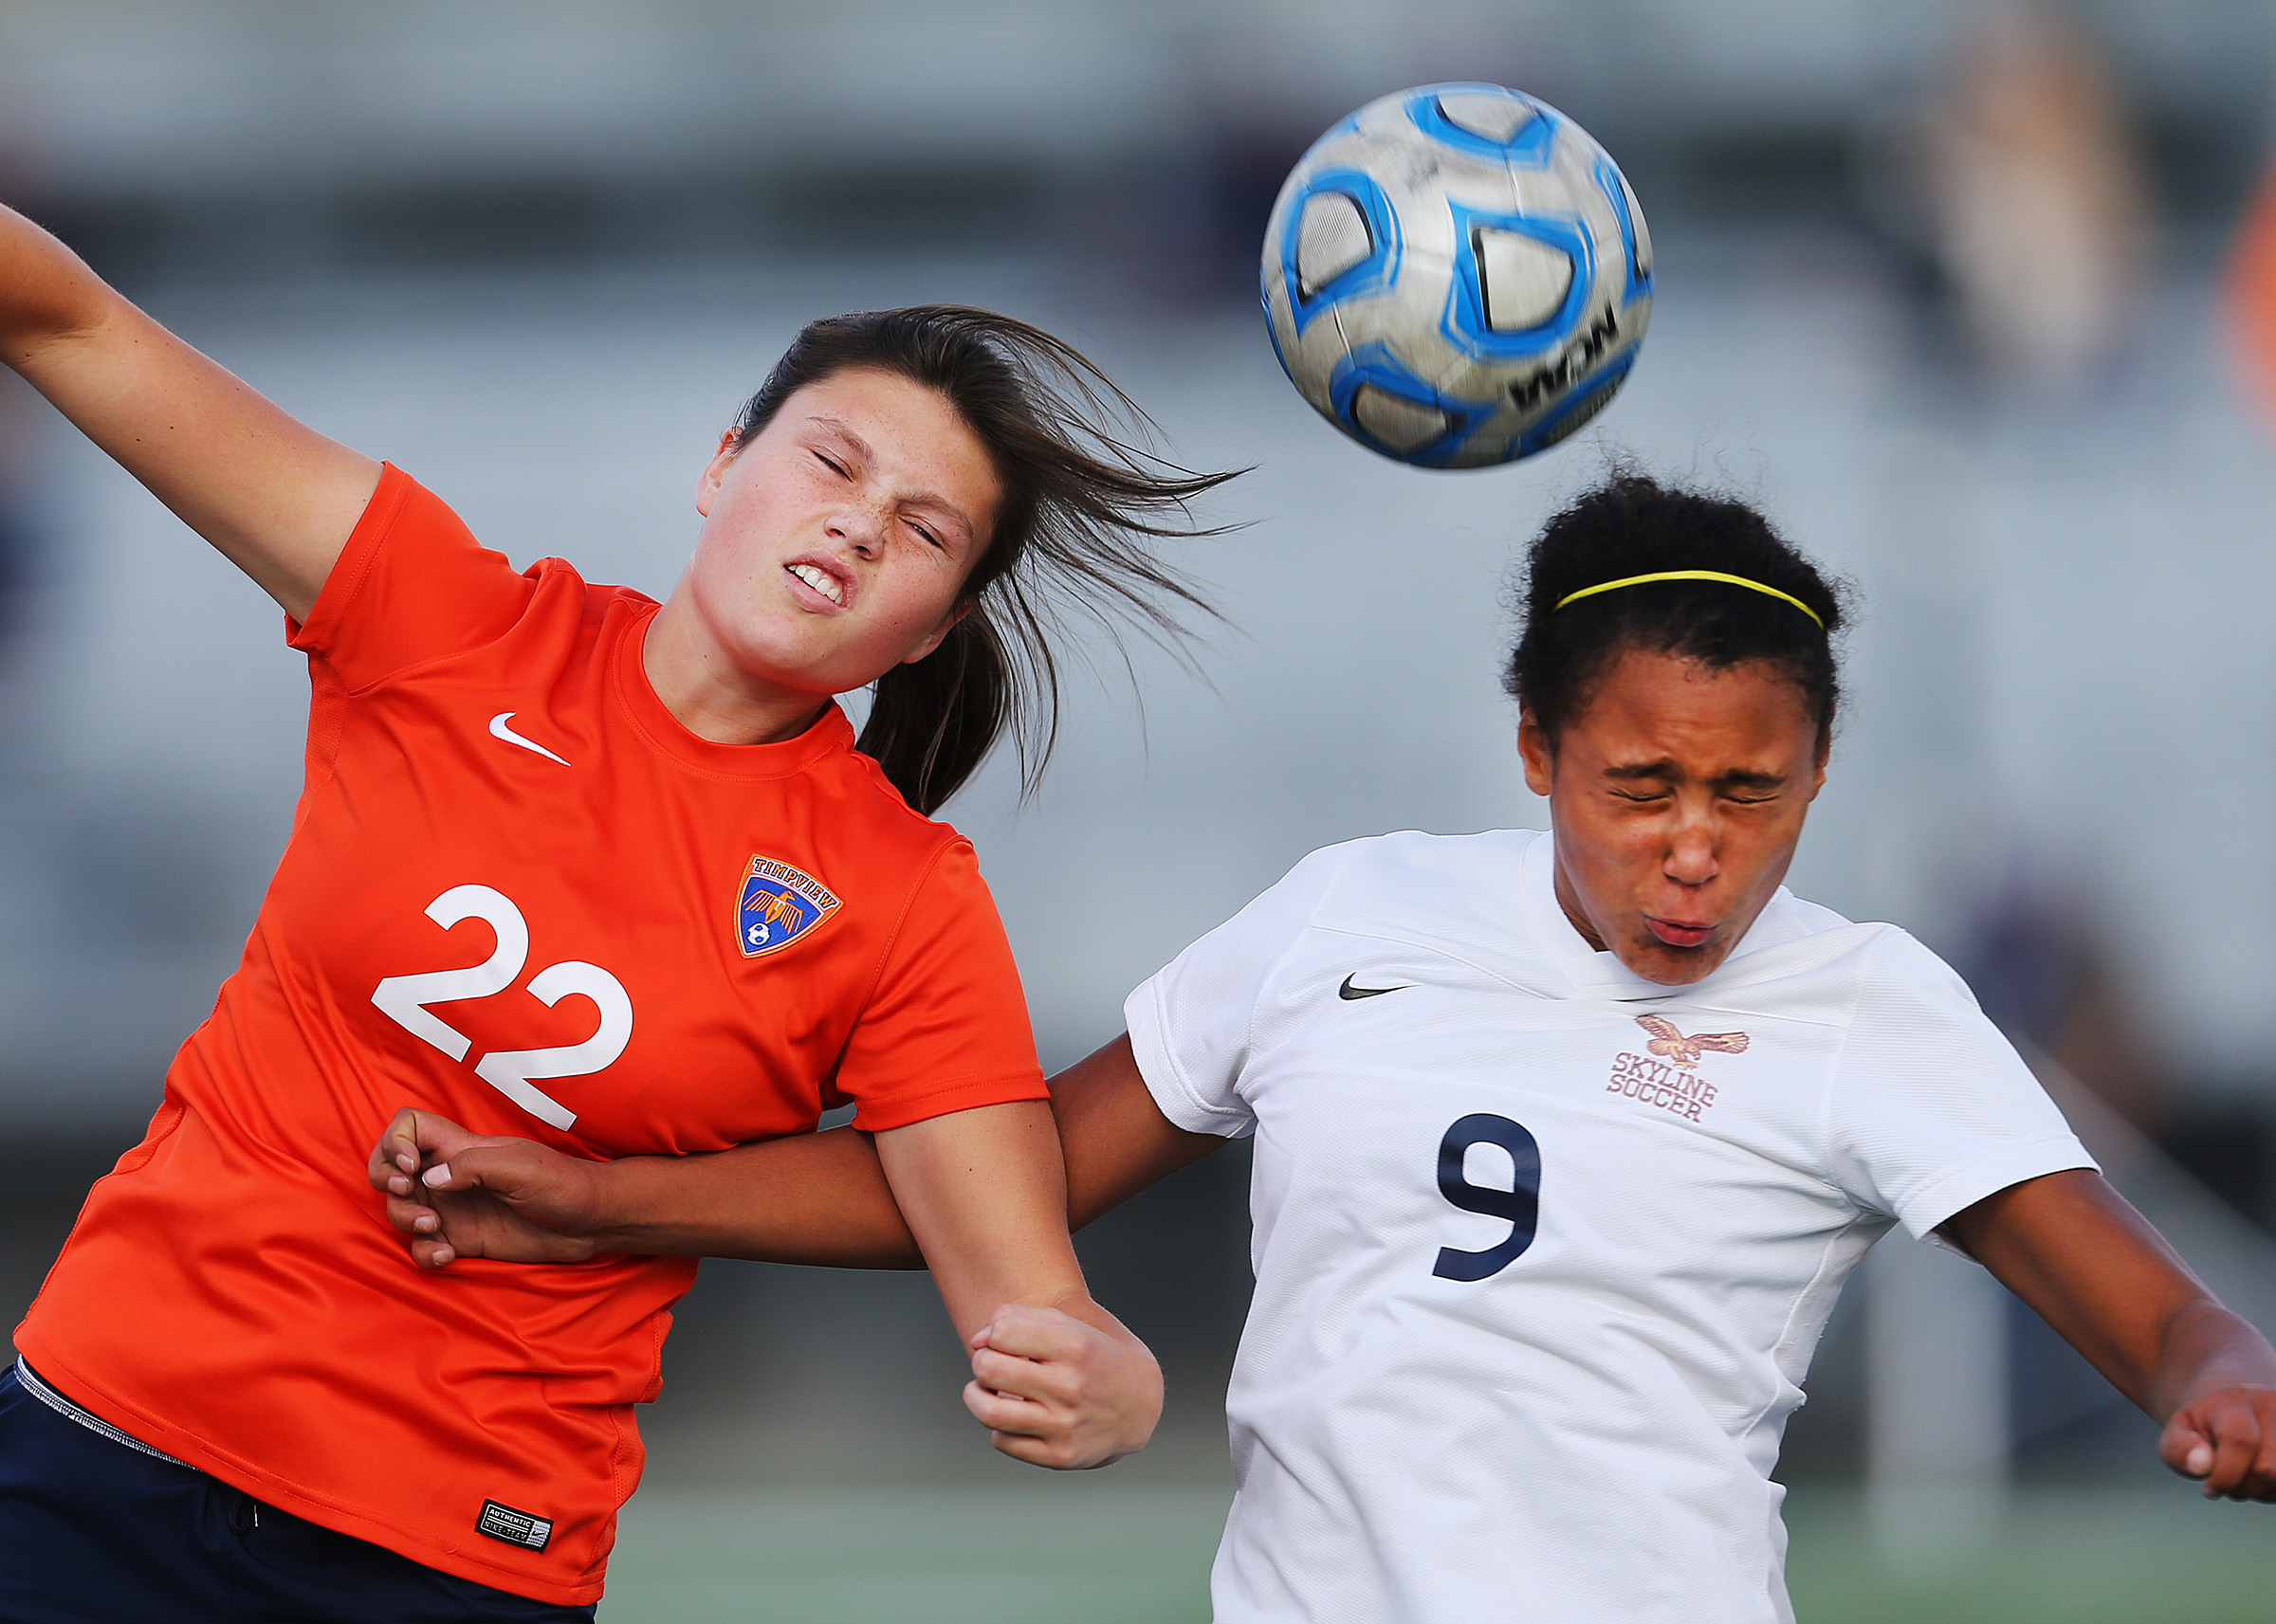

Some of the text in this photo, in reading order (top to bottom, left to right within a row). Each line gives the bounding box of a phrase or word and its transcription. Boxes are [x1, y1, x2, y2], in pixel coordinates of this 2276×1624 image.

[1508, 301, 1618, 411] NCAA
[754, 858, 837, 909] TIMPVIEW
[371, 884, 633, 1132] 22
[1606, 1073, 1700, 1123] SOCCER
[1612, 1052, 1717, 1107] SKYLINE
[1432, 1112, 1541, 1282] 9
[488, 1508, 531, 1528] AUTHENTIC
